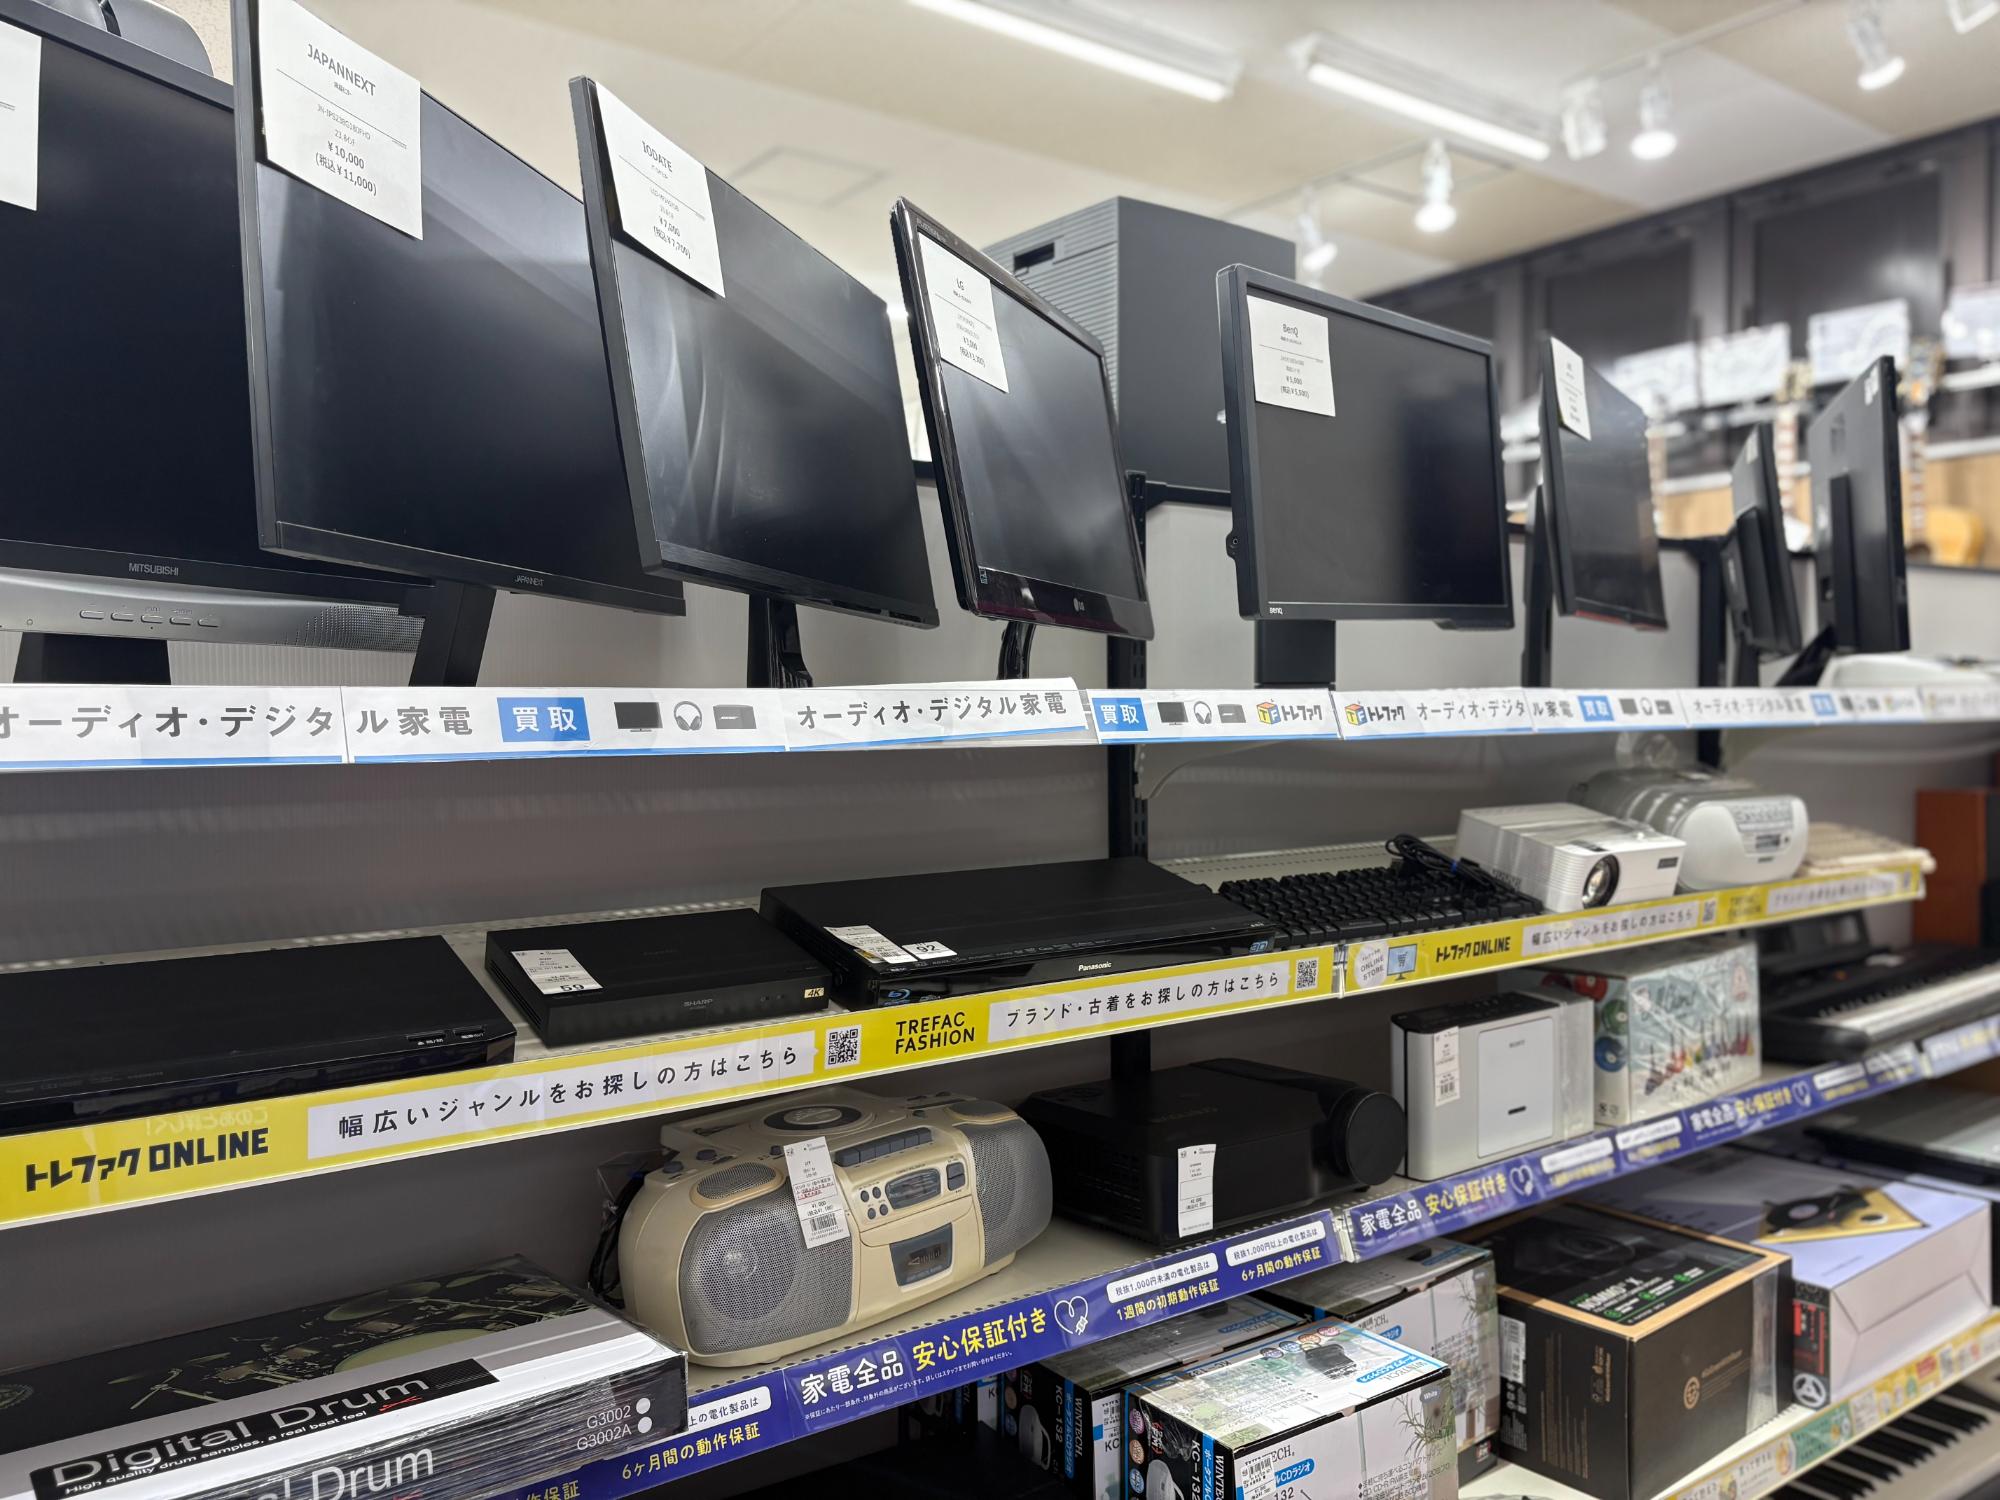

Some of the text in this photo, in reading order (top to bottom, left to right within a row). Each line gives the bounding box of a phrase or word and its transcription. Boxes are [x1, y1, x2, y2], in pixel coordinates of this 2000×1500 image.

[307, 43, 376, 96] JAPANNEXT
[1282, 323, 1299, 338] BenQ
[128, 562, 179, 576] MITSUBISHI
[512, 706, 578, 733] 買取
[797, 692, 1067, 729] オーディオ・デジタル家電
[1100, 703, 1140, 725] 買取
[1282, 704, 1323, 722] トレファク
[1367, 705, 1405, 722] トレファク
[1360, 954, 1385, 972] ONLINE
[1436, 936, 1511, 963] トレファク ONLINE
[1078, 961, 1112, 972] Panasonic
[1362, 964, 1384, 981] STORE
[684, 998, 713, 1007] SHARP
[807, 988, 822, 997] 4K
[1008, 972, 1279, 1028] ブランド・古着をお探しの方はこちら
[896, 1012, 965, 1037] TREFAC
[895, 1028, 975, 1055] FASHION
[338, 1046, 797, 1139] 幅広いジャンルをお探しの方はこちら
[26, 1128, 268, 1192] トレファク ONLINE
[1360, 1199, 1422, 1237] 家電全品
[1425, 1172, 1508, 1217] 安心保証付き
[1116, 1278, 1220, 1321] 1週間の初期動作保証
[800, 1307, 1047, 1405] 家電全品 安心保証付き
[1423, 1390, 1438, 1400] White
[587, 1405, 631, 1429] G3002
[52, 1379, 430, 1488] Digital Drum
[576, 1423, 632, 1451] G3002A
[64, 1479, 102, 1496] High
[105, 1467, 155, 1486] quality
[159, 1455, 197, 1470] drum
[280, 1427, 306, 1438] real
[309, 1418, 340, 1430] beat
[342, 1410, 367, 1421] feel
[311, 1449, 434, 1500] Drum
[1215, 1454, 1225, 1500] WINTE
